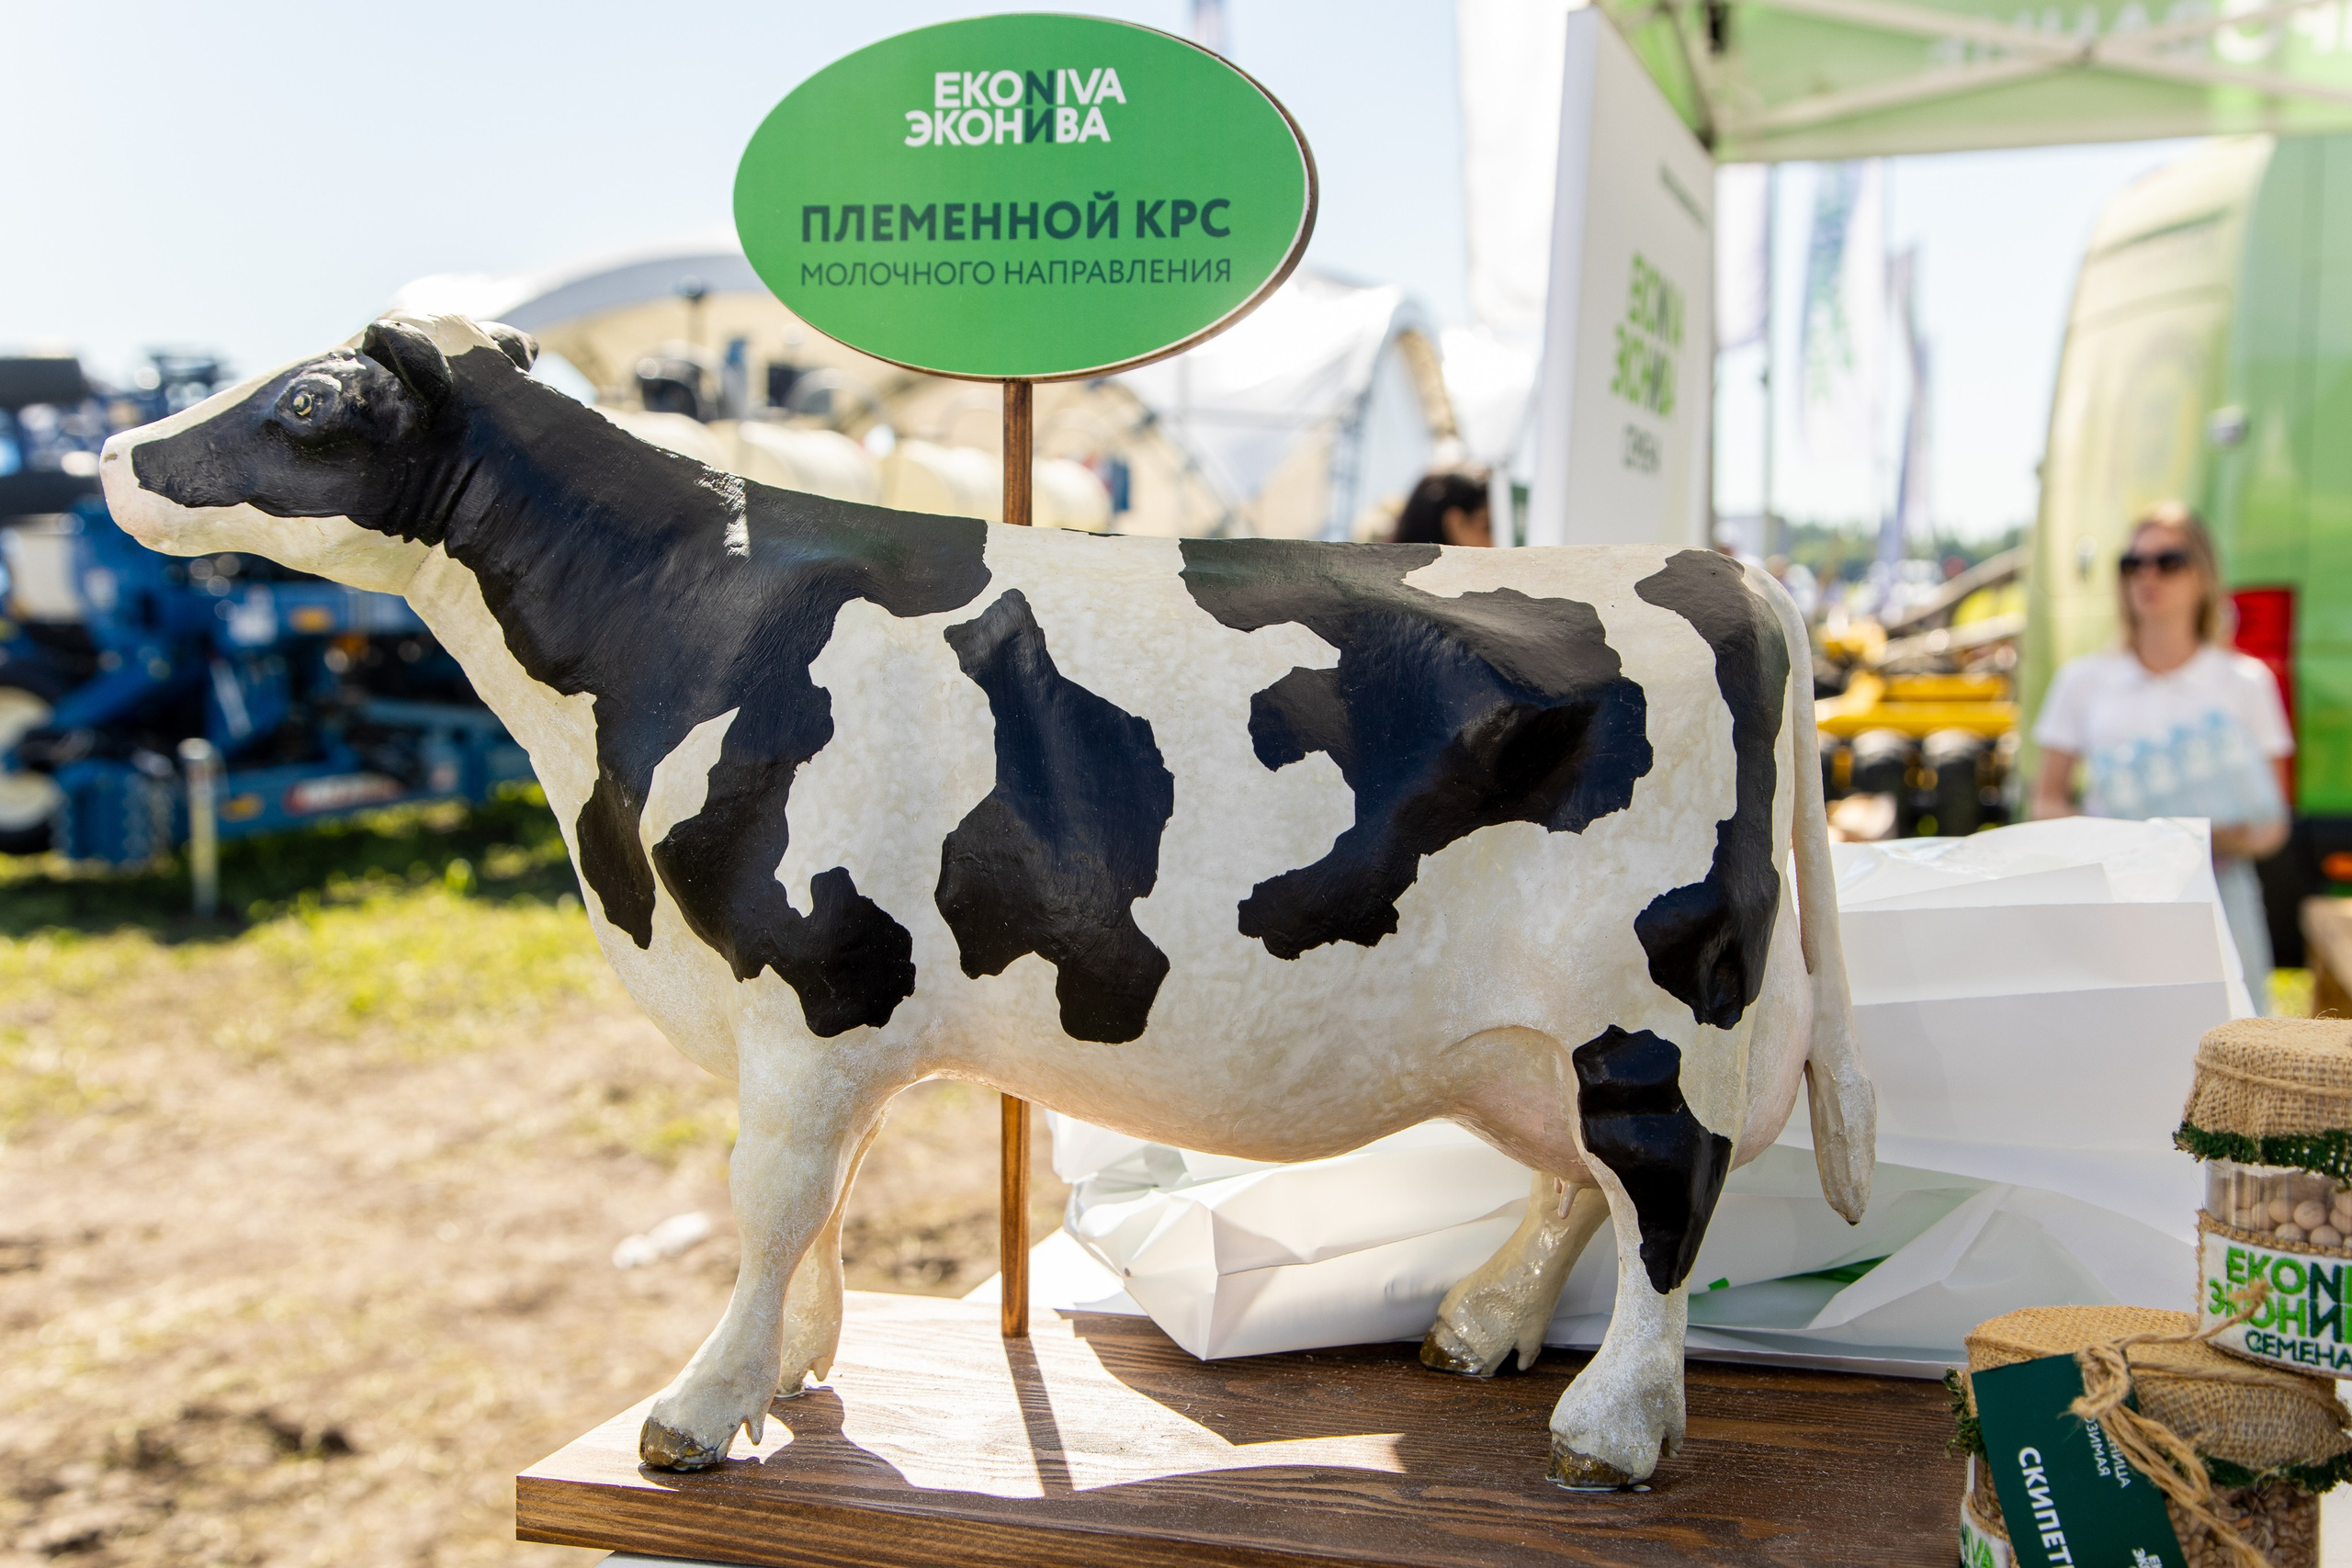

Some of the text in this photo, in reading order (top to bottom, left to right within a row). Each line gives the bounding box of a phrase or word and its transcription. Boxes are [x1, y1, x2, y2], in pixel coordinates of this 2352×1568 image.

[934, 68, 1127, 108] EKONIVA
[904, 107, 1112, 146] ЭКОНИВА
[802, 190, 1231, 243] ПЛЕМЕННОЙ КРС
[801, 258, 1231, 286] МОЛОЧНОГО НАПРАВЛЕНИЯ
[2245, 1329, 2352, 1371] СЕМЕНА
